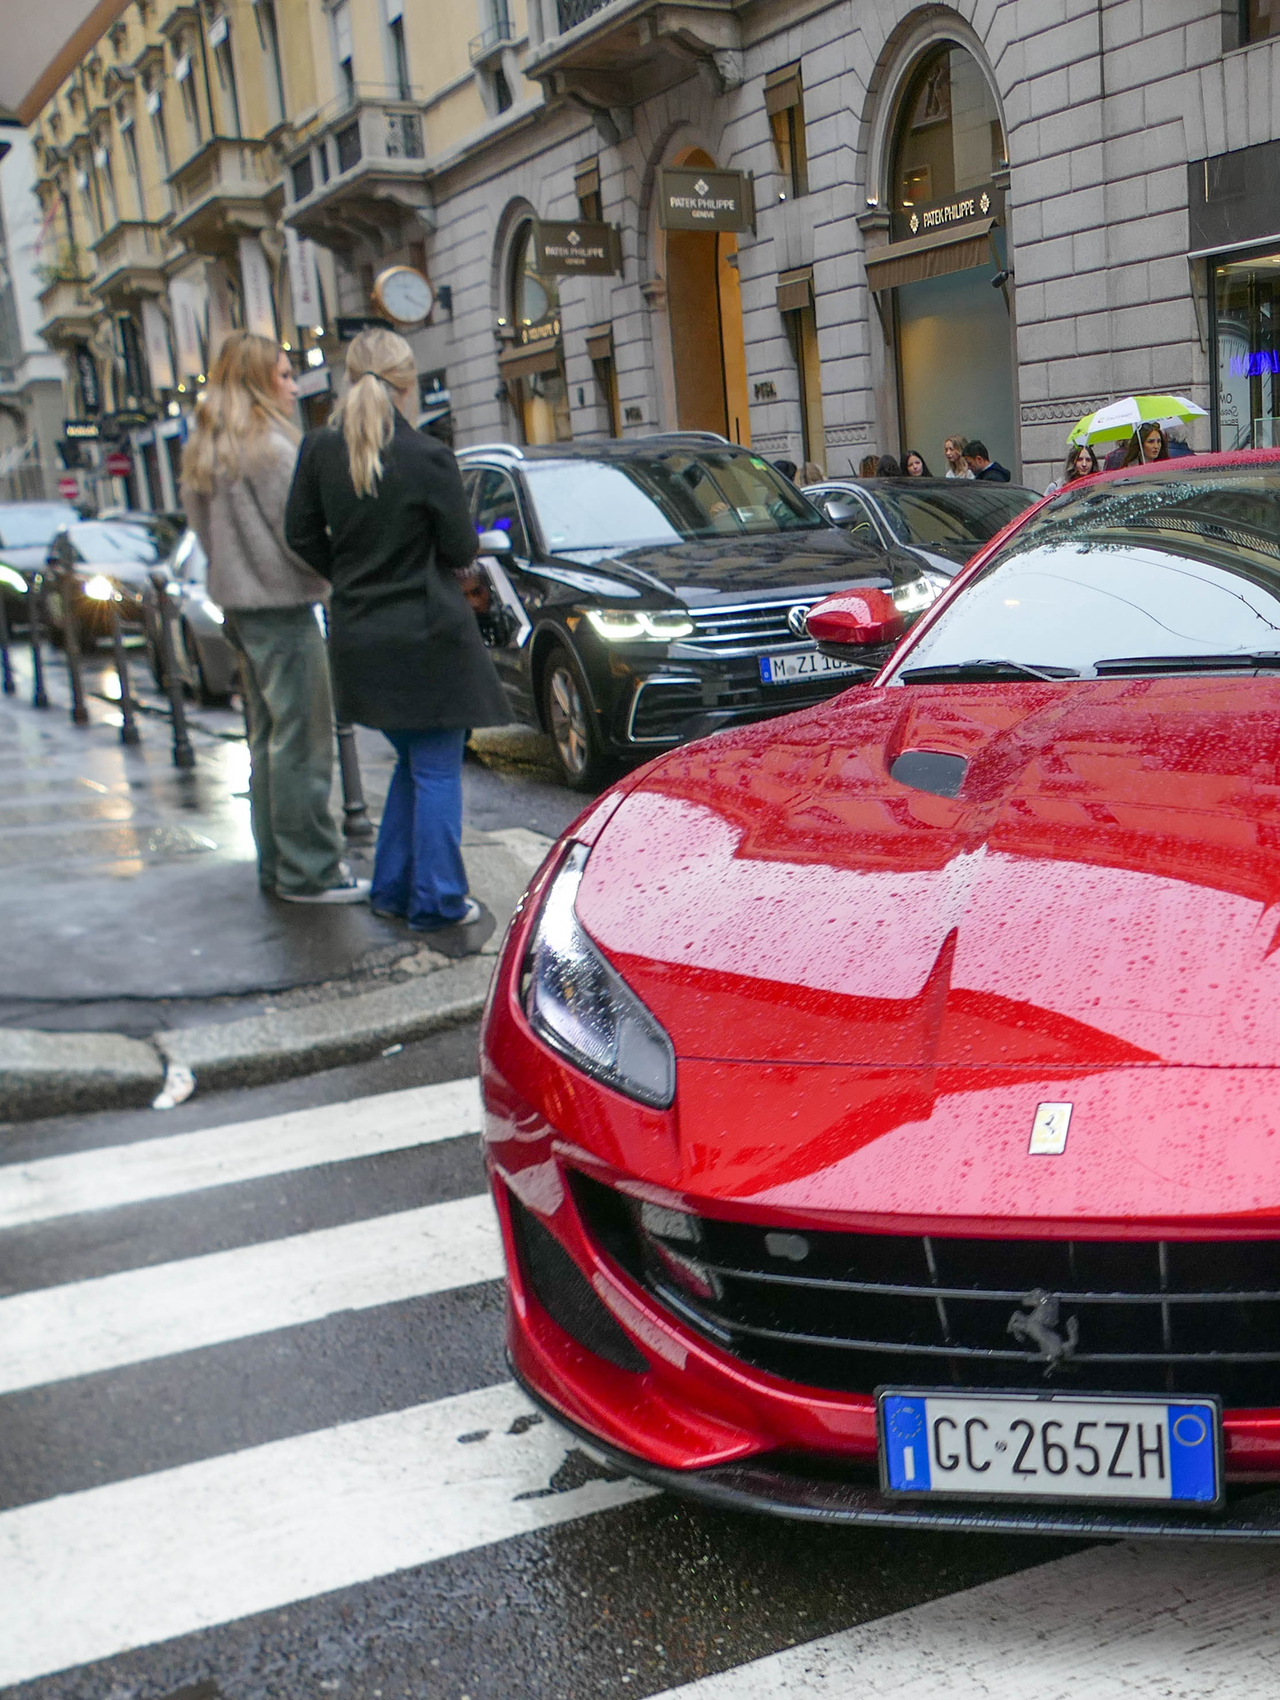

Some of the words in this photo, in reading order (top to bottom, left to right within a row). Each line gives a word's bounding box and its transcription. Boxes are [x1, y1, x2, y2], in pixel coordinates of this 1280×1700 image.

[669, 196, 697, 208] PATEK
[698, 198, 735, 211] PHILIPPE
[923, 208, 945, 228] PATEK
[944, 199, 976, 222] PHILIPPE
[773, 659, 786, 677] M
[796, 655, 818, 674] ZI
[932, 1416, 992, 1473] GC
[1008, 1418, 1166, 1480] 265ZH
